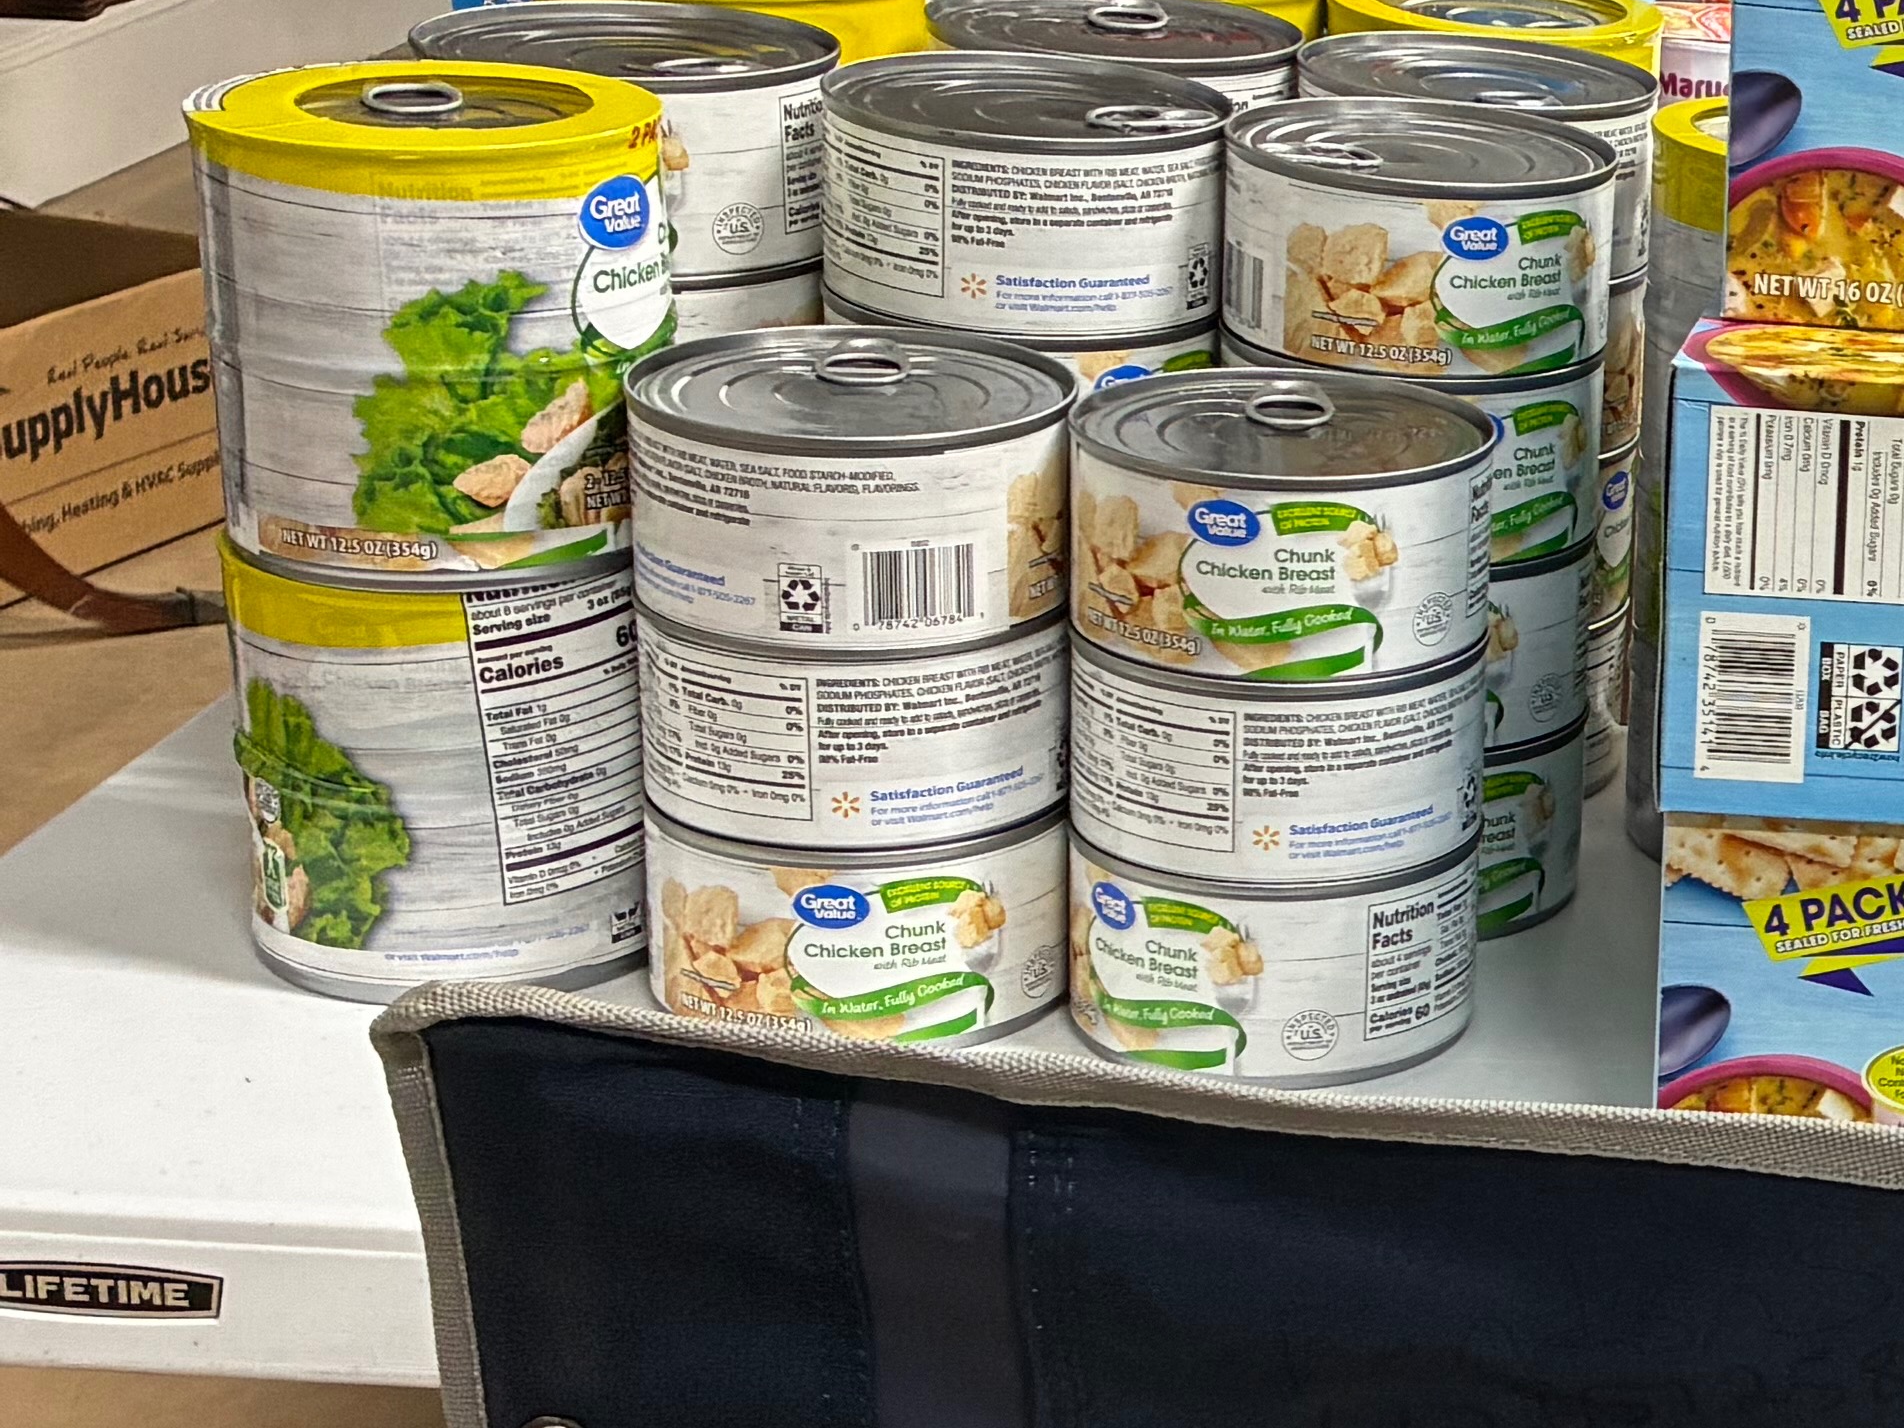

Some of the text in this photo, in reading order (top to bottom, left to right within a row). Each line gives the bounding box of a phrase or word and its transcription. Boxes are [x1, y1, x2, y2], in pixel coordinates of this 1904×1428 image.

[1846, 20, 1900, 41] SEALED
[590, 193, 642, 221] Great
[604, 213, 642, 236] Value
[1518, 254, 1562, 271] Chunk
[592, 260, 660, 295] Chicken
[995, 272, 1151, 291] Satisfaction Guaranteed
[1450, 271, 1562, 290] Chicken Breast
[1753, 273, 1795, 297] NET
[1796, 276, 1833, 300] WT
[1834, 279, 1862, 303] 16
[1866, 281, 1893, 303] OZ
[0, 356, 212, 464] upplyHous
[61, 468, 176, 523] Heating & HVAC
[281, 528, 438, 561] NET WT 12.5 OZ (354g)
[1274, 548, 1335, 564] Chunk
[1196, 560, 1335, 581] Chicken Breast
[885, 921, 946, 940] Chunk
[1764, 904, 1789, 936] 4
[804, 937, 946, 959] Chicken Breast
[1775, 933, 1828, 953] SEALED
[1831, 927, 1862, 943] FOR
[0, 1272, 190, 1308] LIFETIME
